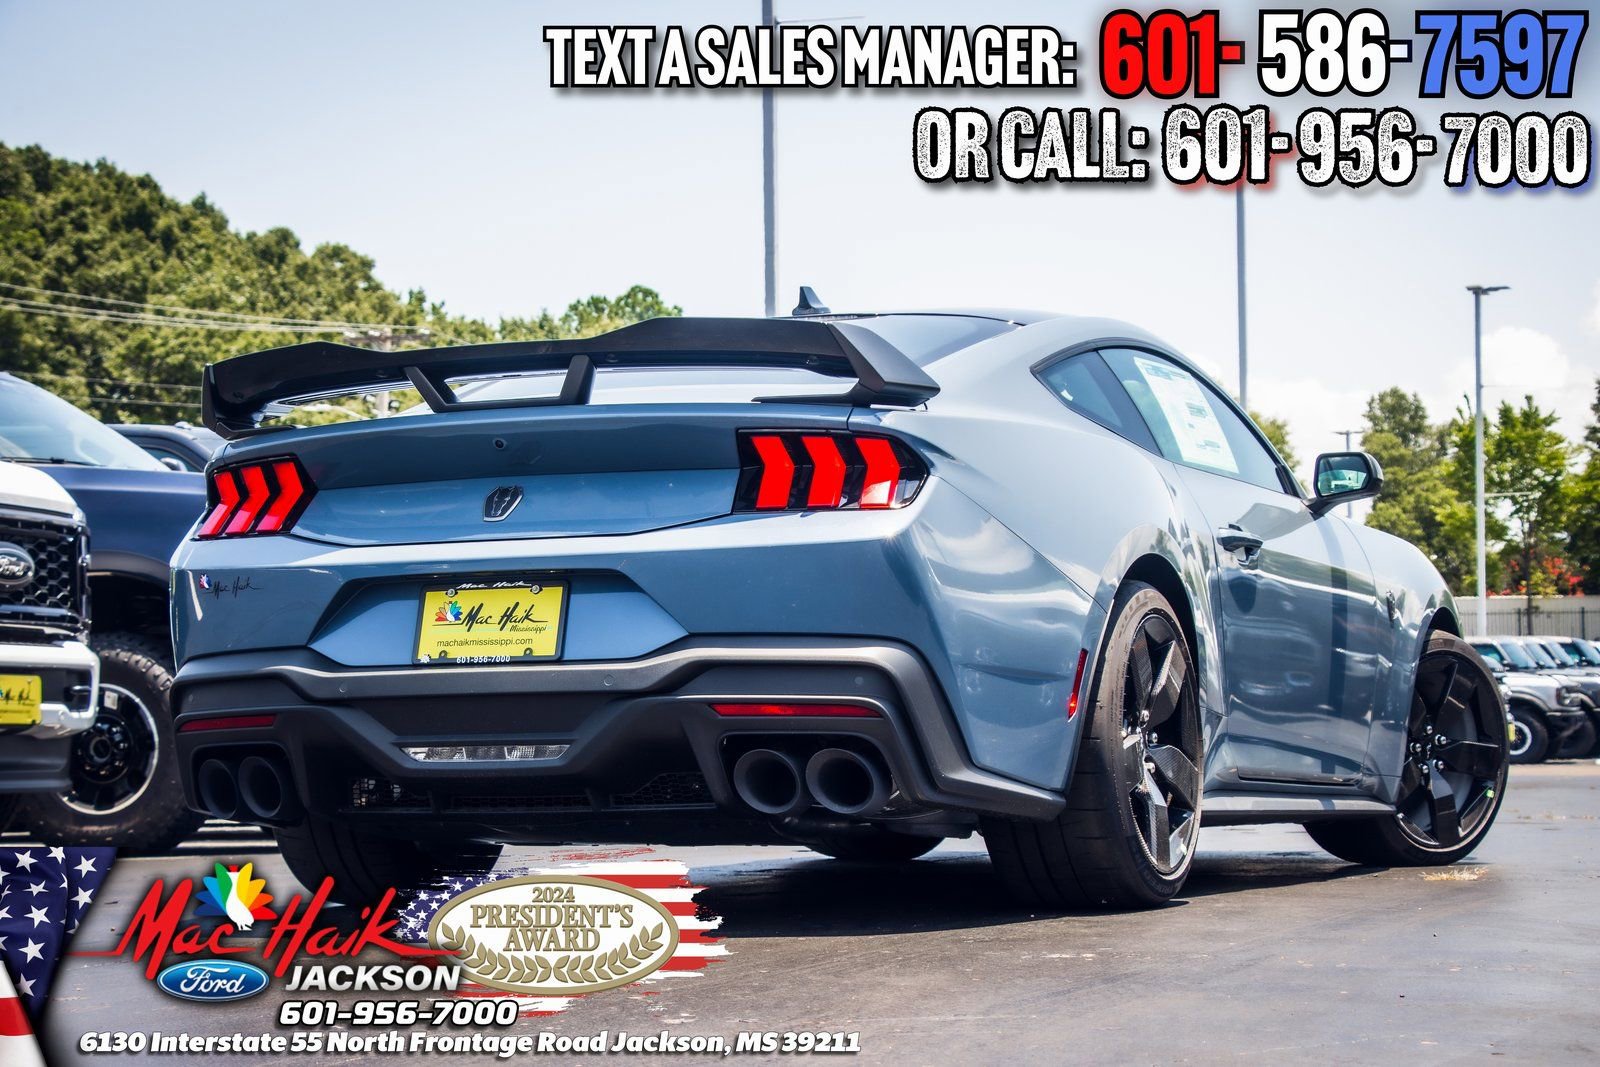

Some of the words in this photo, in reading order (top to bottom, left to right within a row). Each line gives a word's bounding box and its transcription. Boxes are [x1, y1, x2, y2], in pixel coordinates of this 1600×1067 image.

[456, 582, 487, 590] Mac
[492, 580, 531, 588] Haik
[449, 602, 497, 632] Mac
[498, 601, 548, 632] Haik
[509, 624, 548, 634] Mississippi
[436, 637, 533, 647] machaikmississippi.com
[456, 655, 511, 664] 601-956-7000
